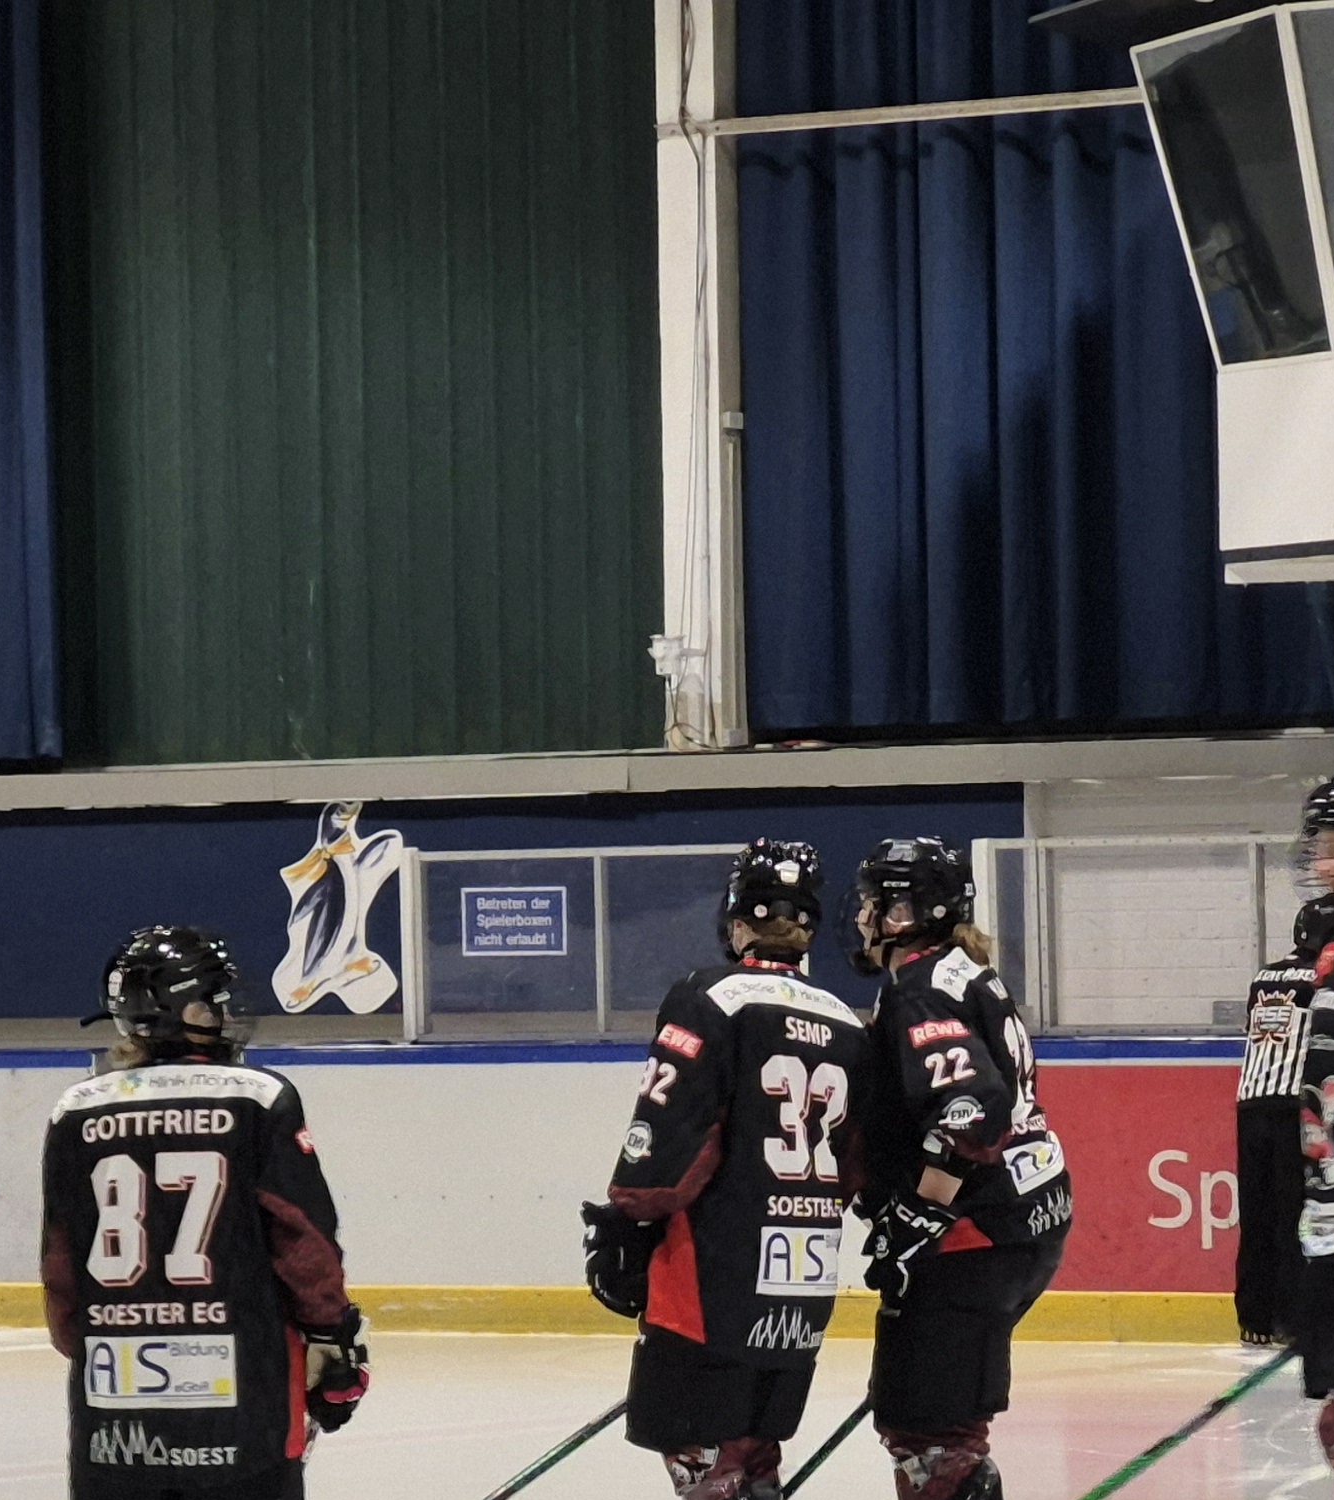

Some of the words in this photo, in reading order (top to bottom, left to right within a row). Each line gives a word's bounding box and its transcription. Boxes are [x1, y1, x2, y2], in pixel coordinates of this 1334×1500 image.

[477, 897, 526, 910] Betreten
[531, 897, 550, 909] der
[476, 914, 552, 929] Spielerboxen
[474, 933, 502, 946] nicht
[506, 933, 547, 945] erlaubt
[660, 1024, 702, 1056] EWE
[785, 1015, 833, 1047] SEMP
[912, 1021, 969, 1047] REWE
[924, 1046, 977, 1089] 22
[81, 1108, 235, 1143] GOTTFRIED
[761, 1054, 849, 1183] 32
[85, 1151, 229, 1287] 87
[87, 1302, 185, 1326] SOESTER
[192, 1301, 227, 1324] EG
[170, 1447, 238, 1467] SOEST
